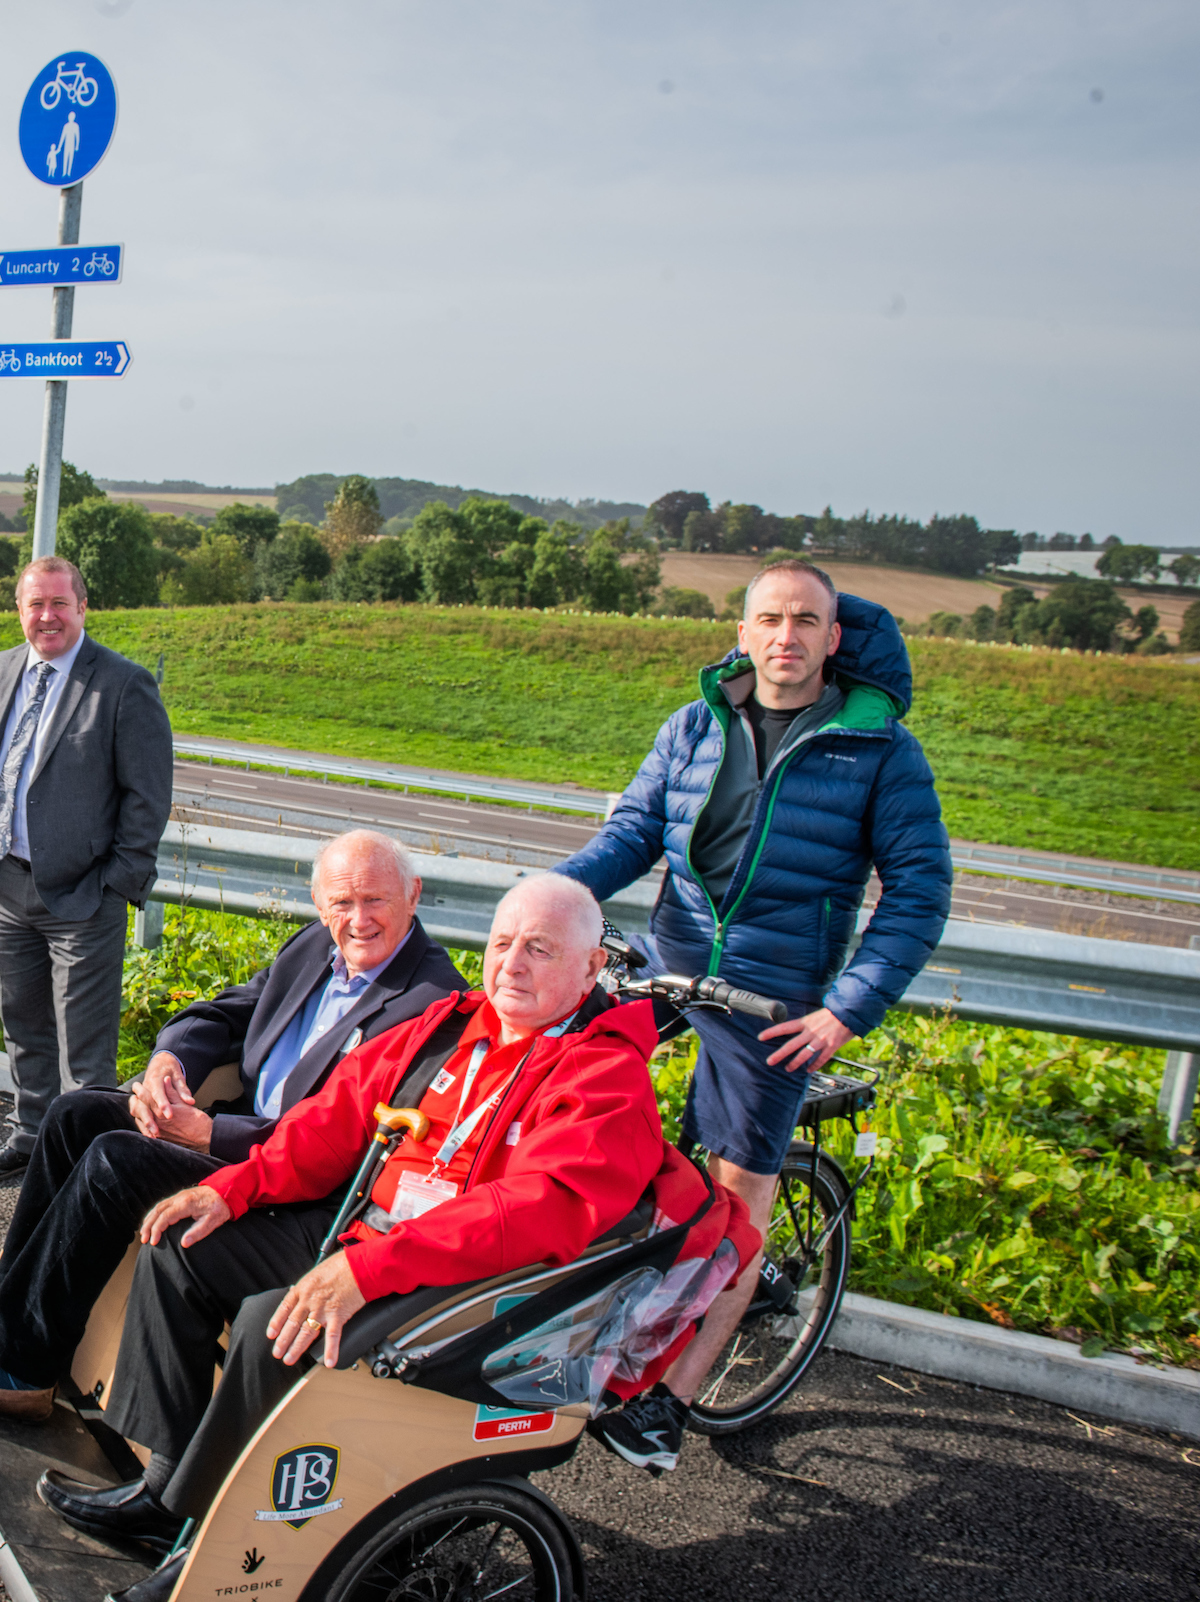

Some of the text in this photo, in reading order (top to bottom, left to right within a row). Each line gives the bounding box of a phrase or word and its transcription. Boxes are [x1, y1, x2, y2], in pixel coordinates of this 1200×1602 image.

[6, 257, 80, 275] Luncarty 2
[25, 352, 83, 366] Bankfoot
[497, 1420, 532, 1433] PERTH
[279, 1512, 297, 1520] More
[300, 1504, 335, 1517] Abundant
[215, 1578, 283, 1597] TRIOBIKE
